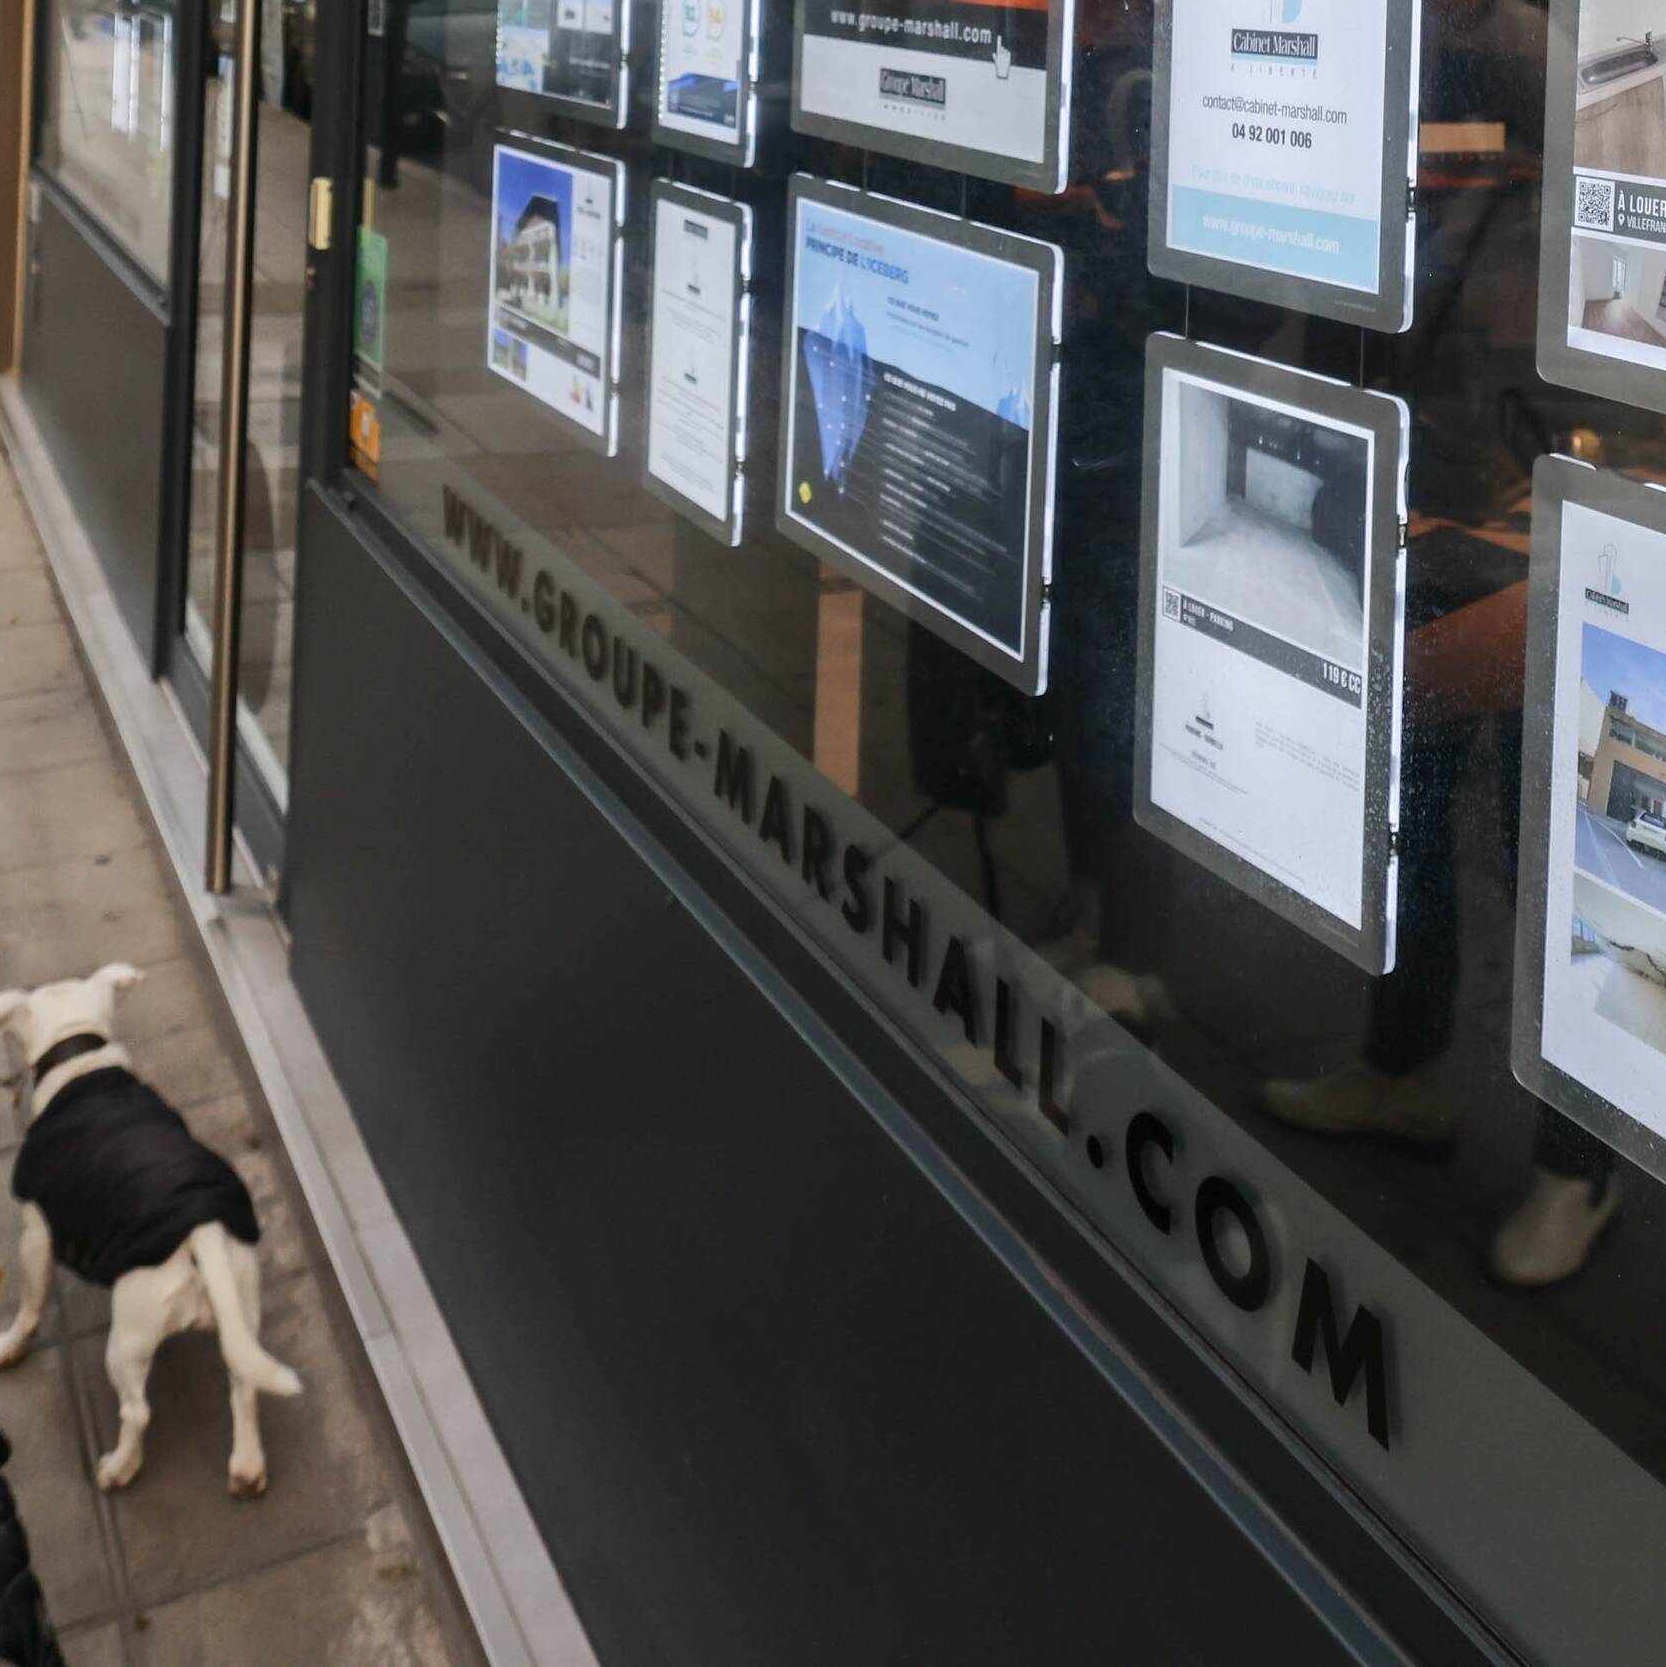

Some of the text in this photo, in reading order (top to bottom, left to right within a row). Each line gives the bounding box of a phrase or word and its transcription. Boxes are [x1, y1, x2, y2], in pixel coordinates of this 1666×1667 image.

[830, 10, 993, 44] www.groupe-marshall.com
[1233, 32, 1316, 57] Cabinet Marshall
[1202, 94, 1348, 125] contact@cabinet-marshall.com
[1232, 123, 1312, 149] 04 92 001 006
[1617, 190, 1626, 212] À
[1202, 214, 1340, 254] www.groupe-marshall.com
[1323, 662, 1362, 695] 119 € CC
[442, 485, 1390, 1451] WWW.GROUPE-MARSHALL.COM
